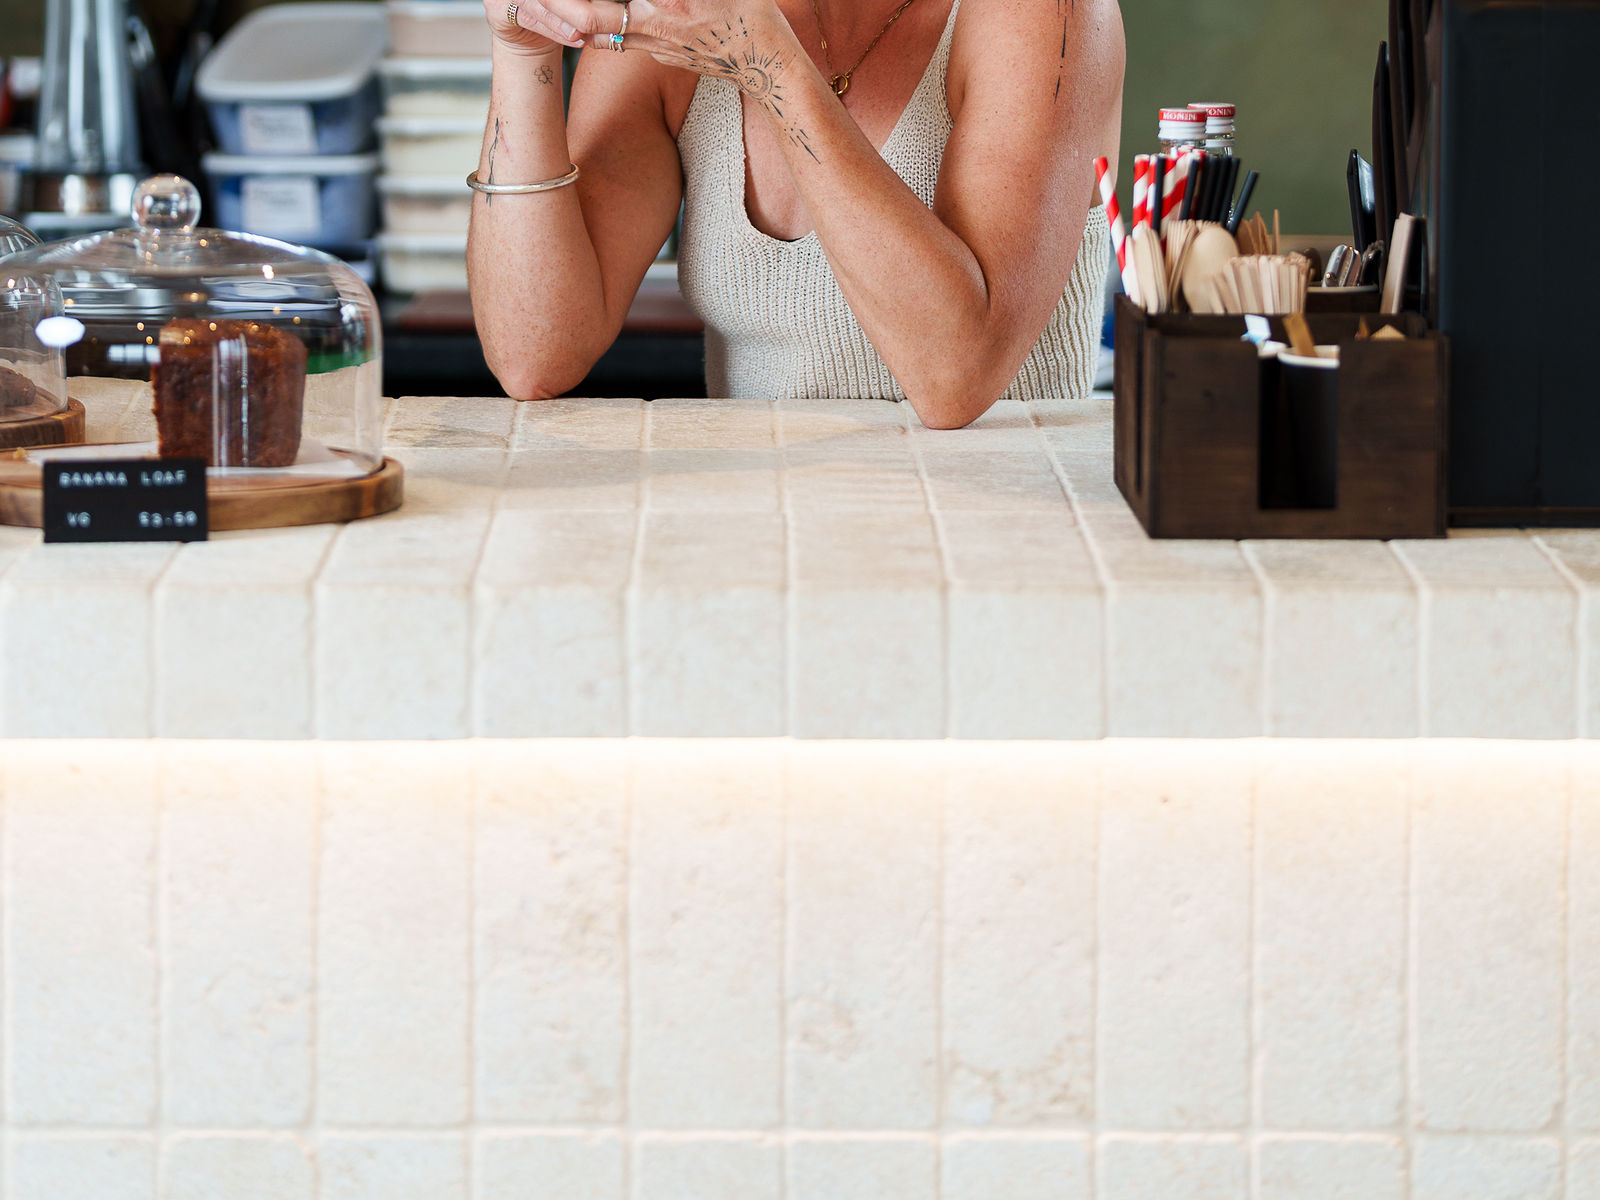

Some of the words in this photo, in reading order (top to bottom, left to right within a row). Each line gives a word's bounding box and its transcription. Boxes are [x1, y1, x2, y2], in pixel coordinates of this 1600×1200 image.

[1163, 112, 1196, 120] MONIN
[59, 471, 128, 488] BANANA
[140, 469, 187, 486] LOAF
